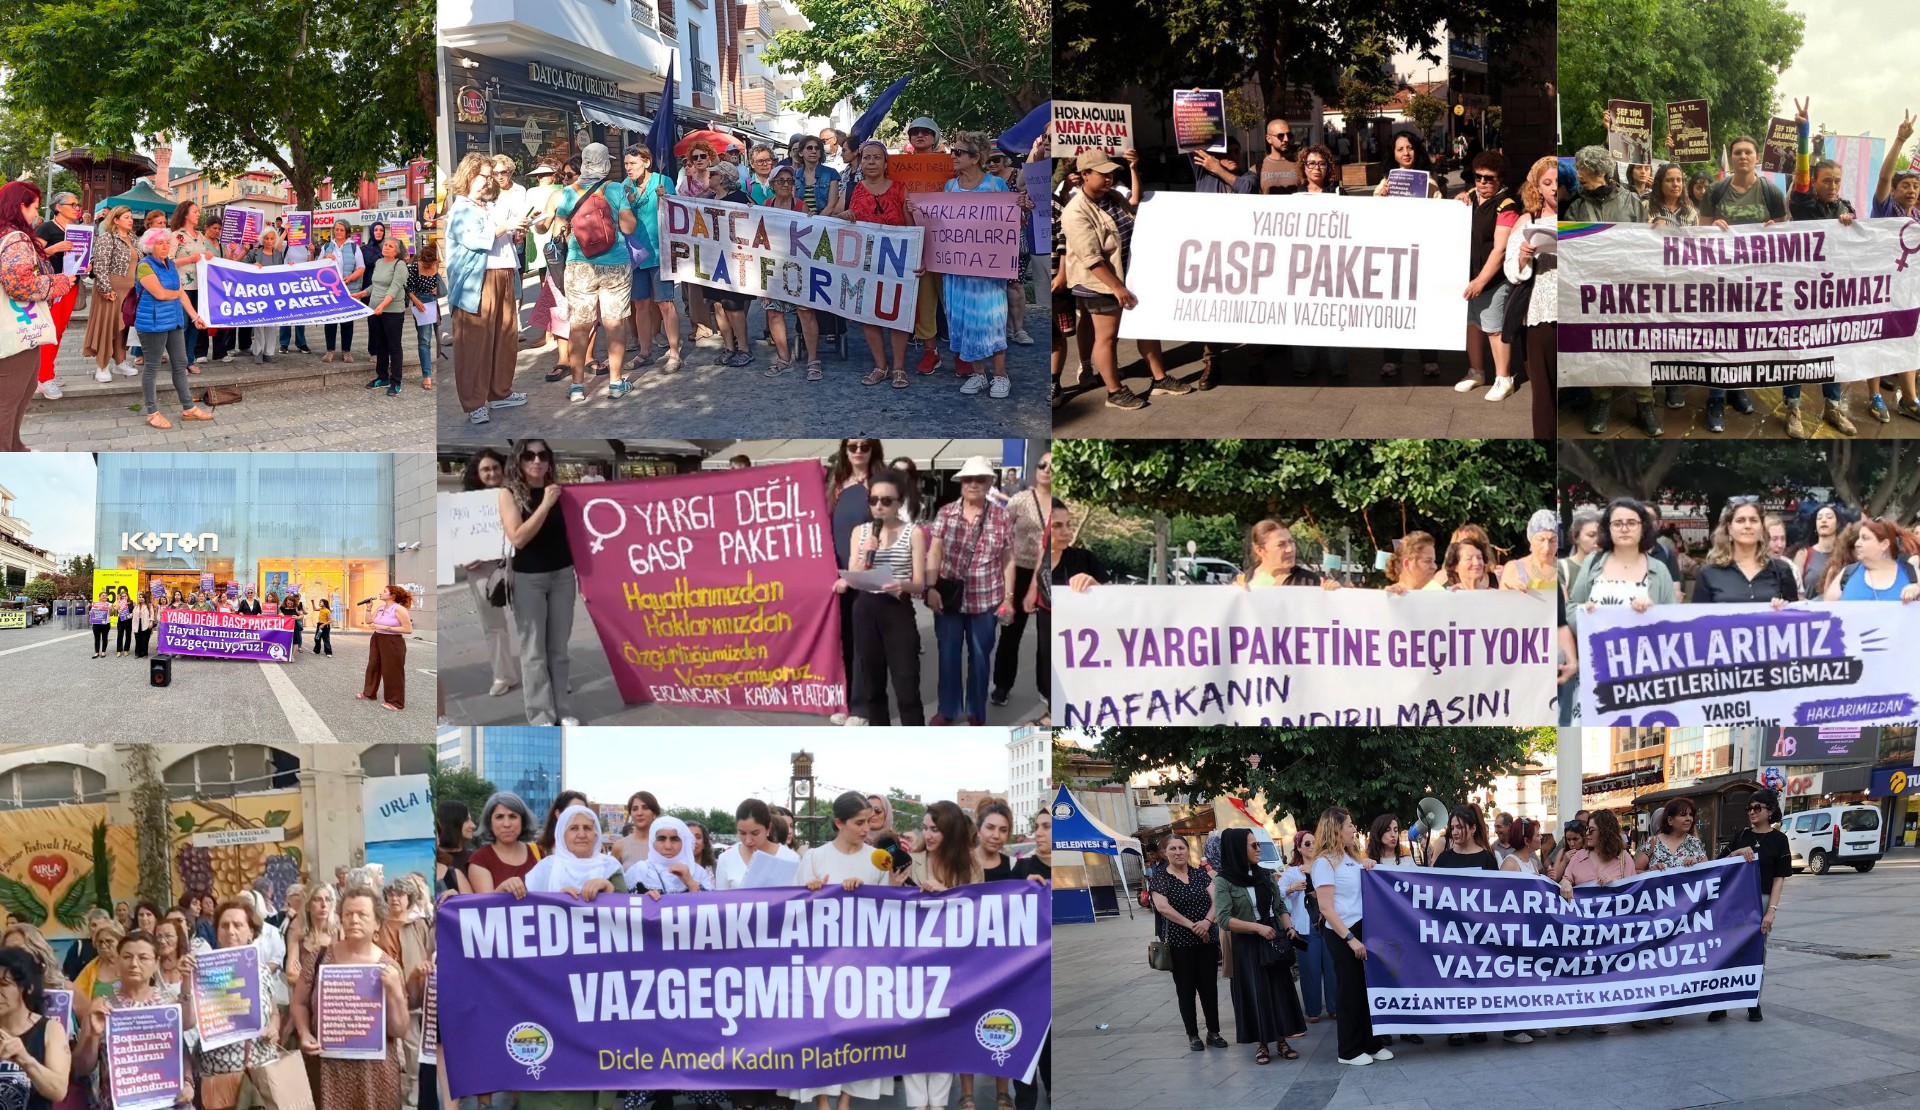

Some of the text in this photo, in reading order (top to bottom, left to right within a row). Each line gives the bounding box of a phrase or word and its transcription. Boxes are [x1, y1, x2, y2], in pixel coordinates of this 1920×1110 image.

[532, 62, 620, 99] DATÇA KÖY ÜRÜNLERİ
[1055, 120, 1128, 137] NAFAKAM
[1057, 133, 1122, 147] SANANE BE
[325, 201, 357, 210] SIGORTA
[376, 209, 413, 222] AYHAN
[919, 205, 1017, 223] HAKLARIMIZ
[314, 216, 335, 225] OSCH
[1252, 210, 1353, 239] YARGI DEĞİL
[668, 201, 909, 279] DATÇA KADIN
[931, 228, 1017, 246] TORBALARA
[1663, 231, 1826, 266] HAKLARIMIZ
[935, 251, 1001, 270] SIĞMAZ
[1176, 239, 1420, 301] GASP PAKETİ
[222, 276, 326, 298] YARGI DEĞİL
[669, 240, 904, 322] PLATFORMU
[1580, 271, 1892, 315] PAKETLERİNİZE SIĞMAZ!
[219, 290, 339, 318] GASP PAKETİ
[1173, 298, 1416, 332] HAKLARIMIZDAN VAZGEÇMİYORUZ!
[1591, 318, 1884, 351] HAKLARIMIZDAN VAZGEÇMİYORUZ!
[1651, 359, 1836, 384] ANKARA KADIN PLATFORMU
[633, 475, 816, 536] YARGI DEĞİL,
[628, 535, 695, 575] GASP
[622, 569, 785, 618] Hayatlarımızdan
[166, 611, 193, 625] YARGI
[194, 613, 220, 627] DEĞİL
[222, 615, 245, 629] GASP
[167, 624, 261, 641] Hayatlarımızdan
[642, 603, 793, 640] Haklarımızdan
[165, 635, 265, 654] Vazgeçmiyoruz!
[622, 637, 769, 674] Özgürlüğümüzden
[1058, 619, 1550, 676] 12. YARGI PAKETİNE GEÇİT YOK!
[1604, 619, 1832, 679] HAKLARIMIZ
[674, 663, 826, 692] Vazgeçmiyoruz...
[1612, 660, 1850, 704] PAKETLERİNİZE SIĞMAZ!
[650, 682, 731, 705] ERZİNCAN
[744, 686, 789, 707] KADIN
[1064, 674, 1291, 726] NAFAKANIN
[1701, 701, 1751, 722] YARGI
[1806, 699, 1905, 721] HAKLARIMIZDAN
[379, 791, 420, 818] URLA
[24, 837, 60, 854] Festivali
[1055, 840, 1100, 849] BELEDİYESİ
[33, 863, 62, 876] URLA
[1680, 877, 1722, 905] VE
[459, 893, 1038, 959] MEDENİ HAKLARIMIZDAN
[1418, 909, 1714, 948] HAYATLARIMIZDAN
[568, 955, 951, 1036] VAZGEÇMİYORUZ
[1373, 973, 1757, 1011] GAZİANTEP DEMOKRATİK KADIN PLATFORMU
[112, 1031, 173, 1046] Boşanmayı
[112, 1042, 172, 1055] kadınların
[113, 1052, 165, 1065] haklarını
[598, 1040, 907, 1071] Dicle Amed Kadın Platformu
[114, 1065, 139, 1078] gasp
[116, 1072, 161, 1086] etmeden
[117, 1080, 179, 1097] hızlandırın.
